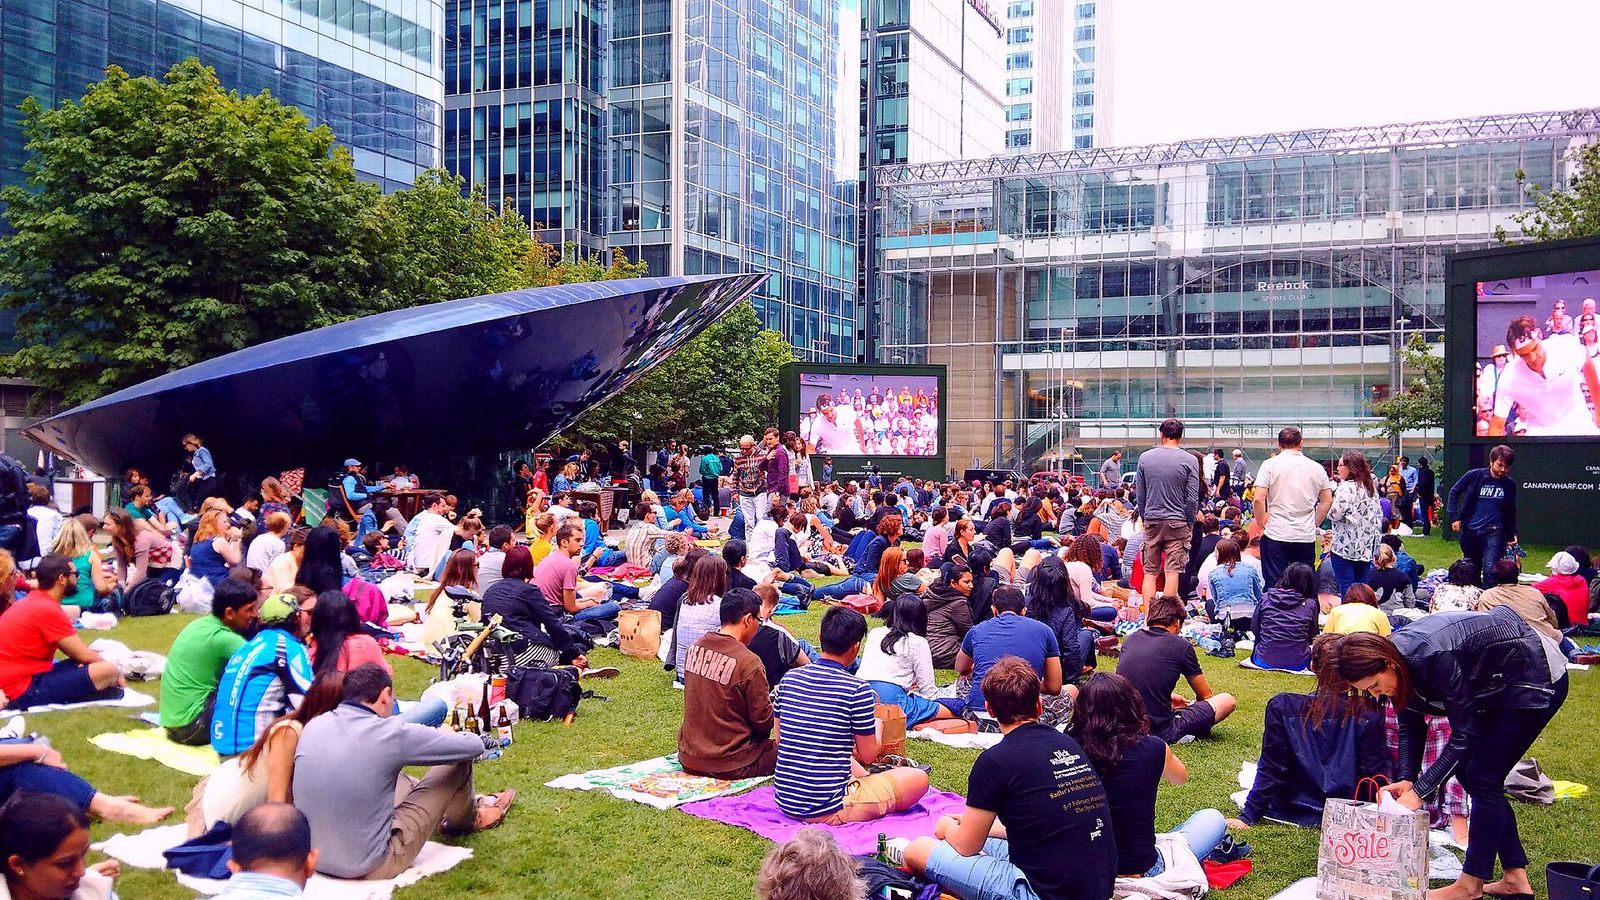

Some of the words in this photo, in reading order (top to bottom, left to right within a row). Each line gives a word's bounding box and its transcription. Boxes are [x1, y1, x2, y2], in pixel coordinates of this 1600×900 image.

[1257, 279, 1309, 291] Reebok
[1522, 482, 1594, 490] CANARYWHARF.COM
[1053, 750, 1070, 758] Dick
[1334, 832, 1390, 866] Sale
